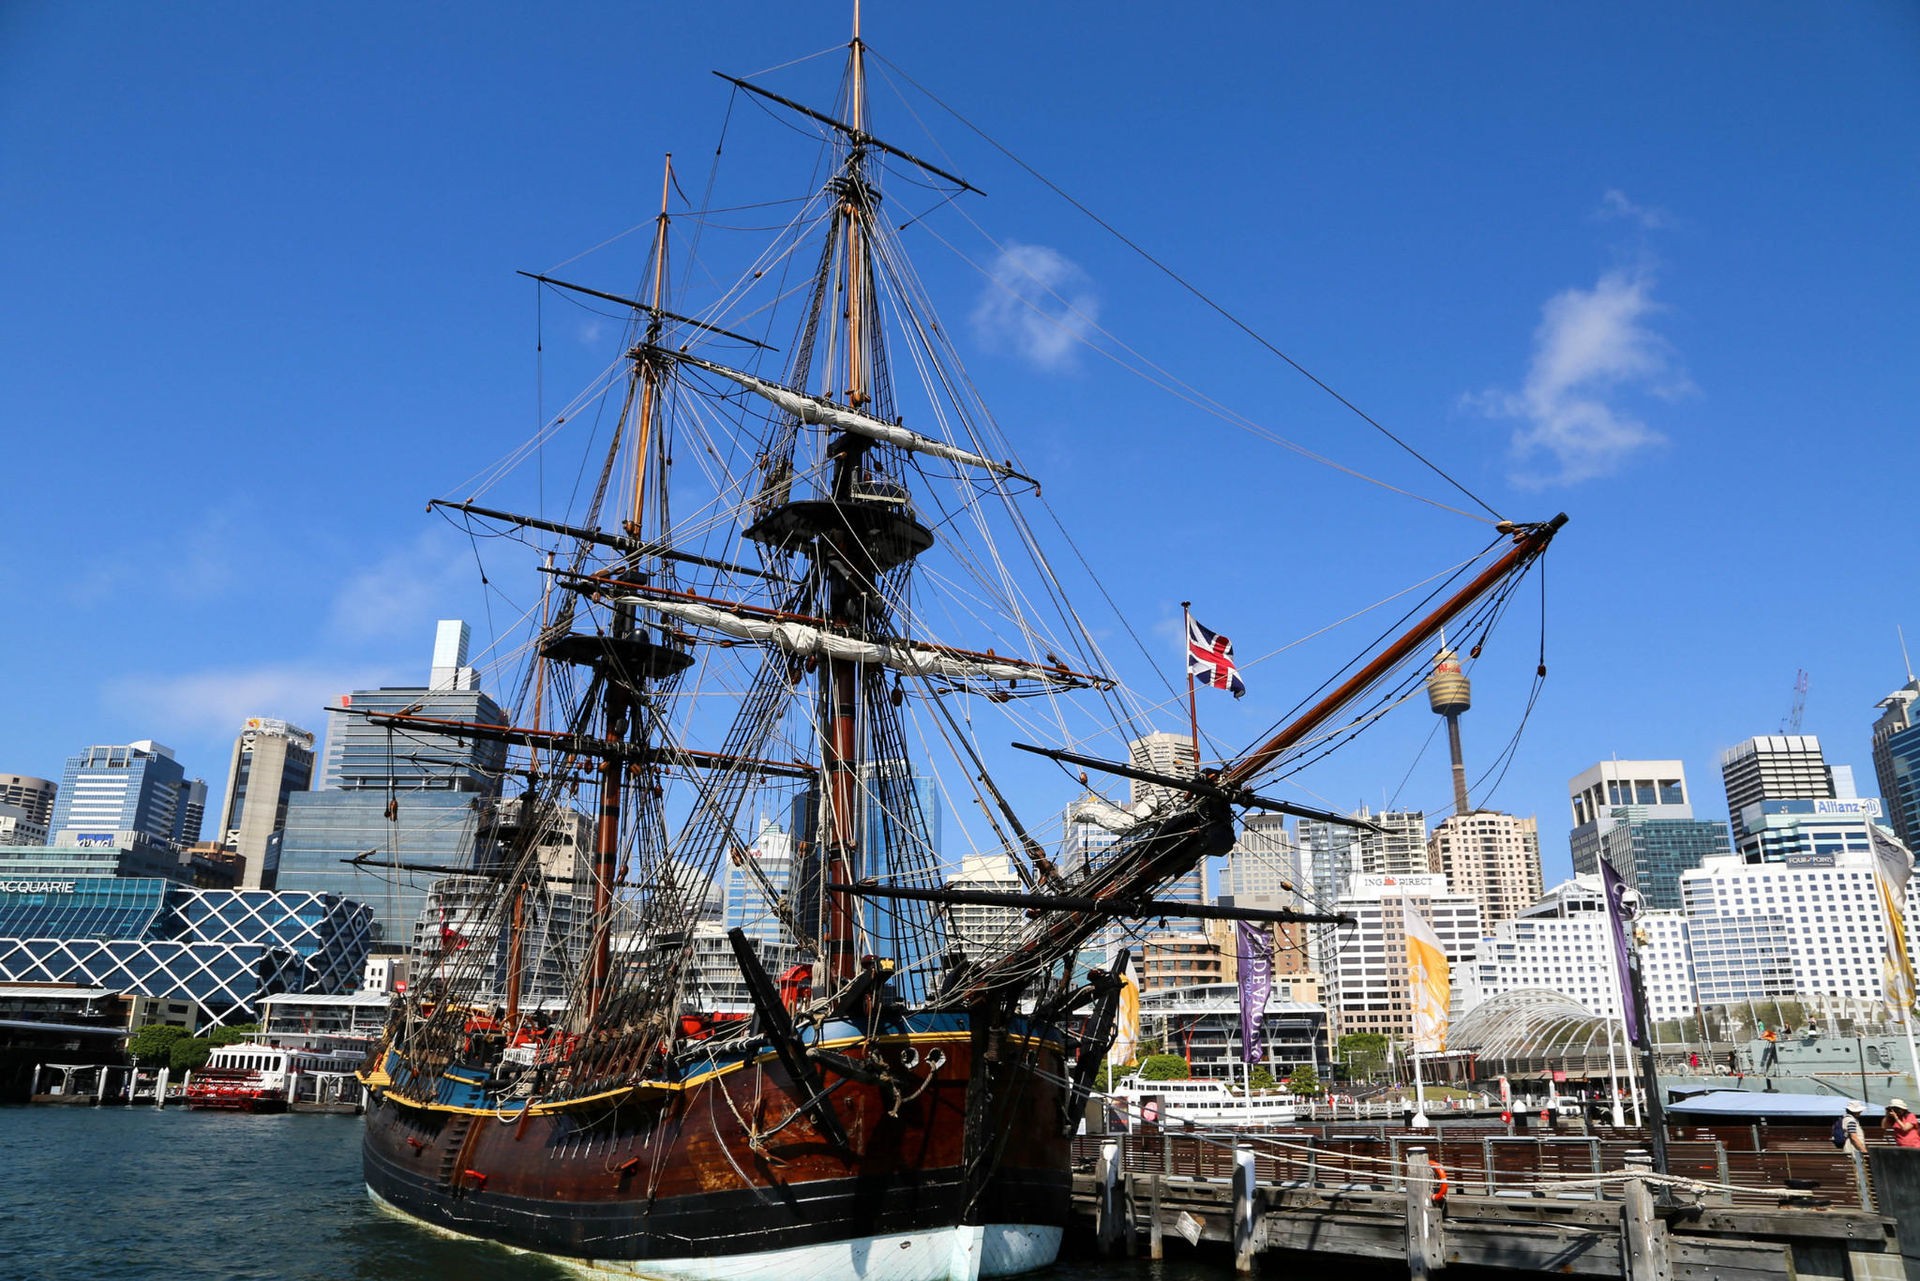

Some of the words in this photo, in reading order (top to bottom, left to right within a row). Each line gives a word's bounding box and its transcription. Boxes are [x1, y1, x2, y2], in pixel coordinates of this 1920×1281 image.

[1818, 801, 1860, 813] Allianz
[1365, 878, 1382, 886] ING
[1399, 878, 1432, 886] DIRECT
